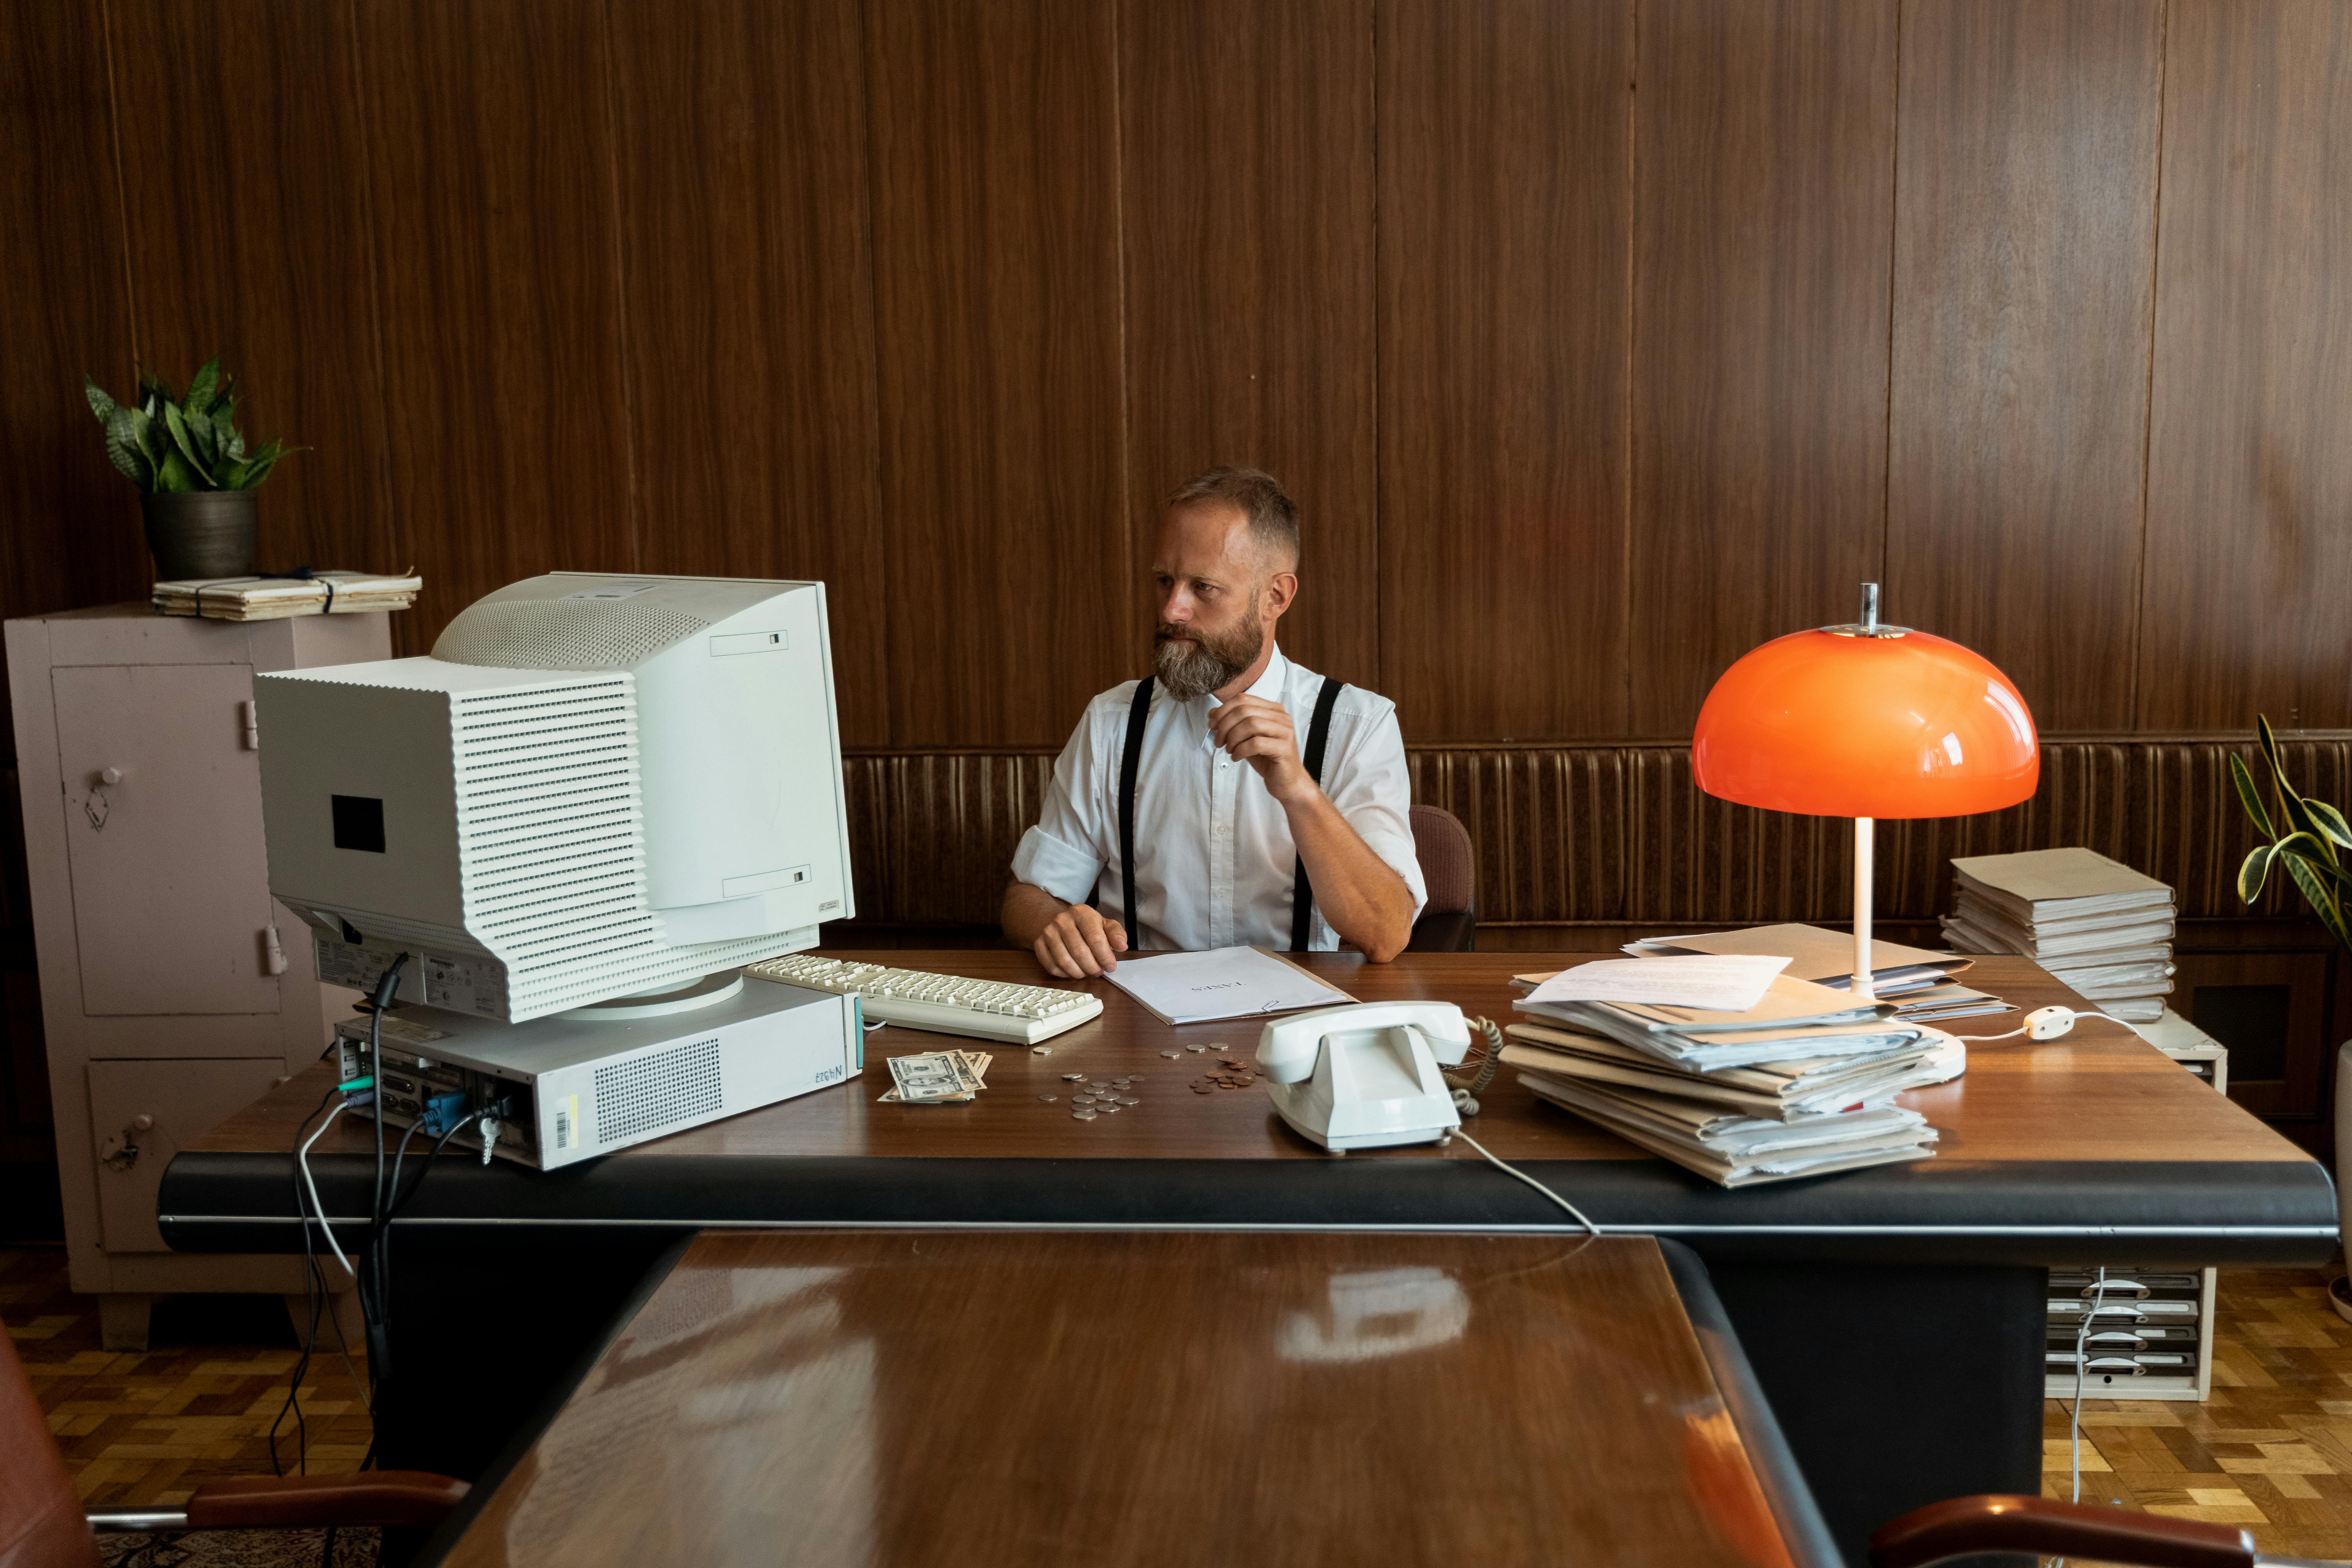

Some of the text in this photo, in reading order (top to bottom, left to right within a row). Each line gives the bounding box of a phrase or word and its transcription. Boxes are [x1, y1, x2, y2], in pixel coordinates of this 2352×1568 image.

[1191, 982, 1247, 991] TAXES
[816, 1065, 842, 1083] N4927
[943, 1060, 953, 1074] DOLLARS
